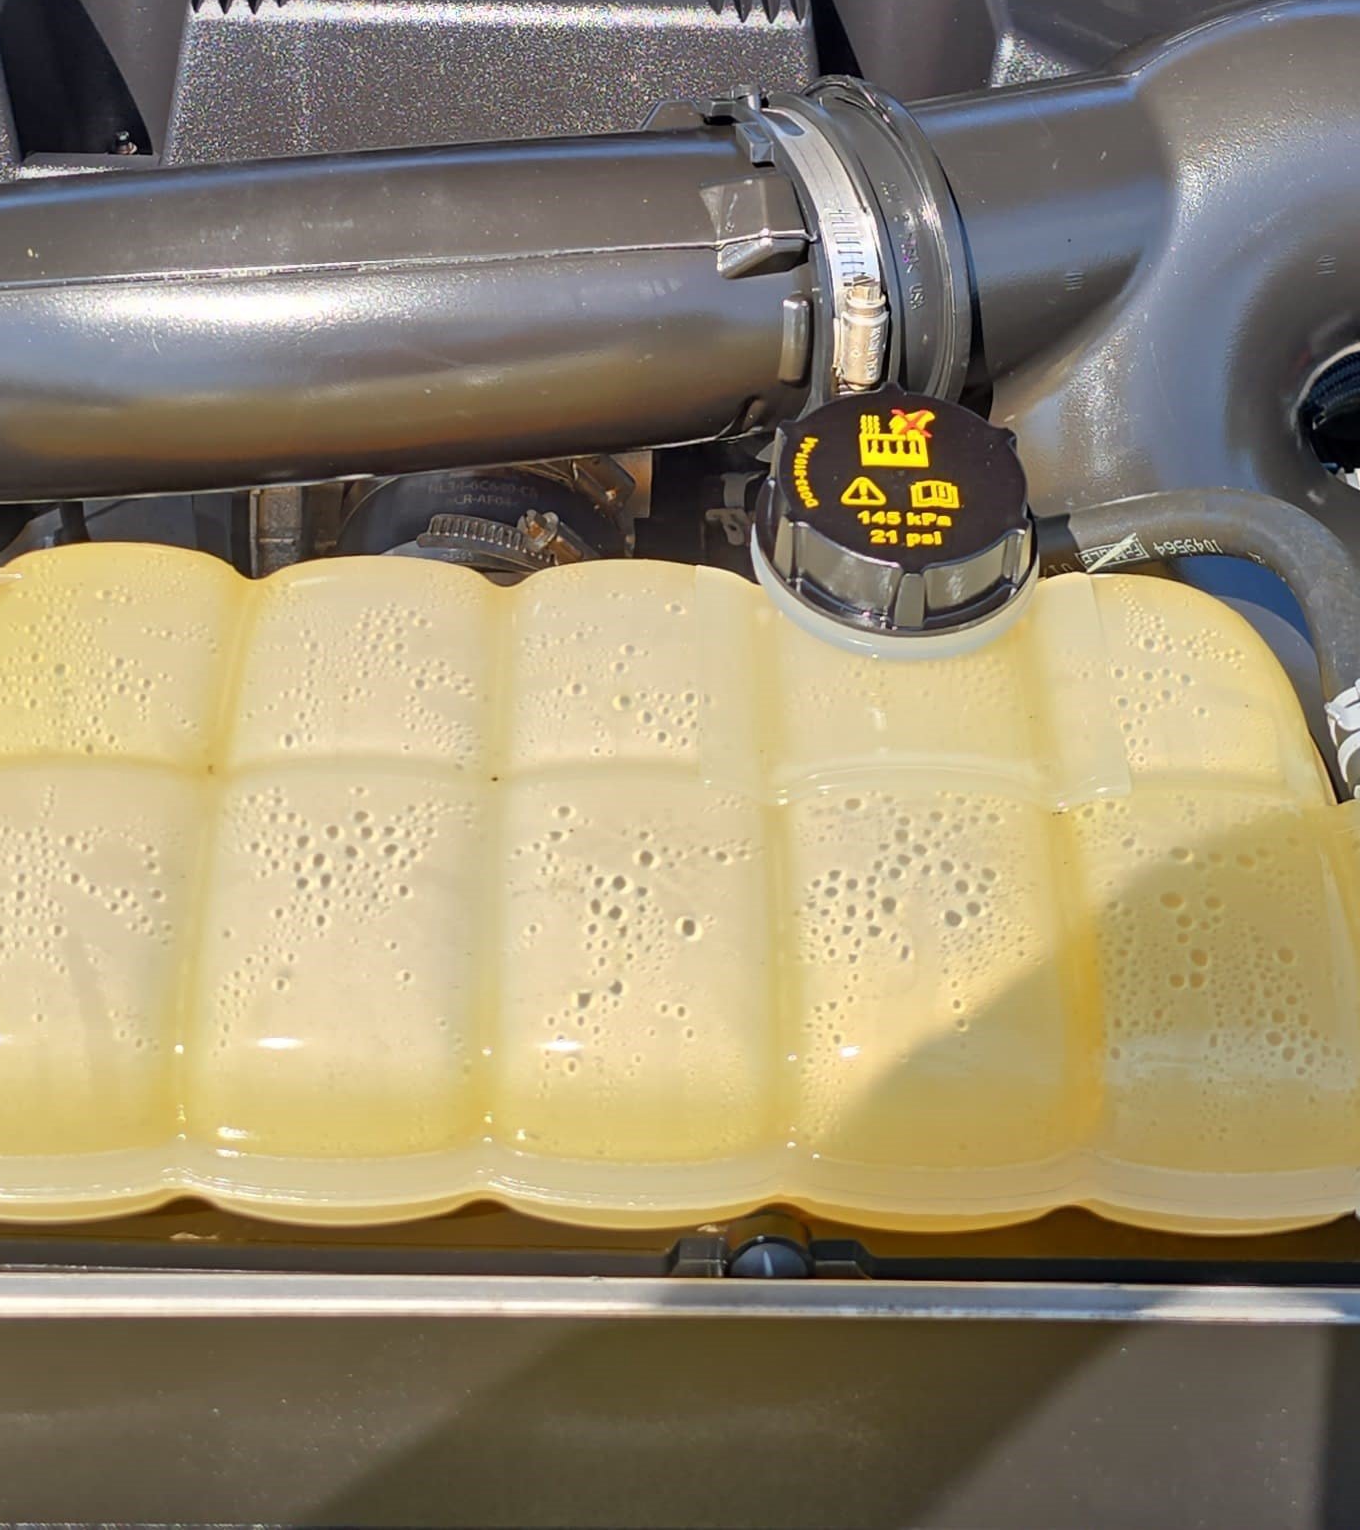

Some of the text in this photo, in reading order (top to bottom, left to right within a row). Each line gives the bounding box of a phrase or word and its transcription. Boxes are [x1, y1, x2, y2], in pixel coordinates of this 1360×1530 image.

[857, 510, 952, 527] 145 kPa
[870, 529, 942, 547] 21 psi
[1153, 539, 1223, 556] 1049564
